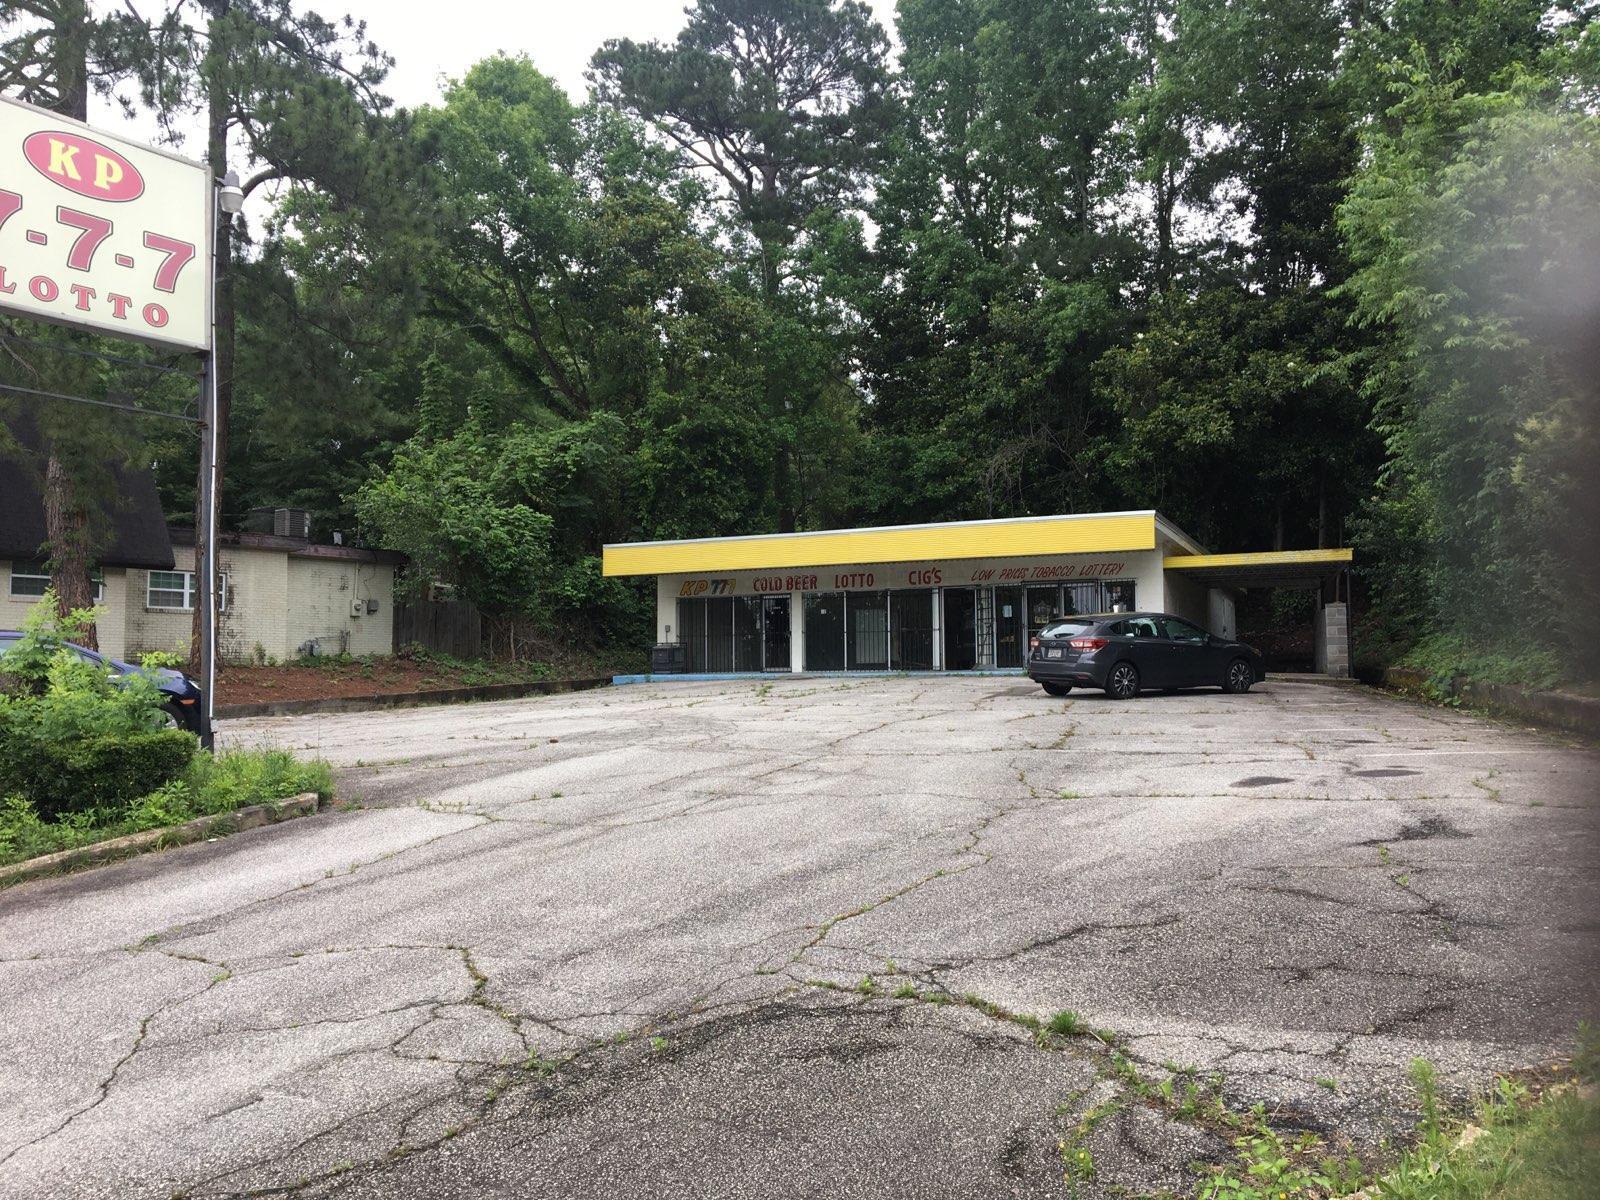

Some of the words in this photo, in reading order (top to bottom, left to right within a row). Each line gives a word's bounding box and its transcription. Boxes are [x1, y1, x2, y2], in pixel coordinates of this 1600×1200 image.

[834, 573, 875, 588] LOTTO
[908, 567, 942, 585] CIG'S
[971, 569, 993, 581] LOW
[1032, 566, 1075, 577] TOBACCO
[1079, 563, 1125, 577] LOTTERY
[680, 580, 708, 596] KP
[711, 578, 737, 595] 777
[753, 576, 783, 592] COLD
[786, 574, 818, 590] BEER
